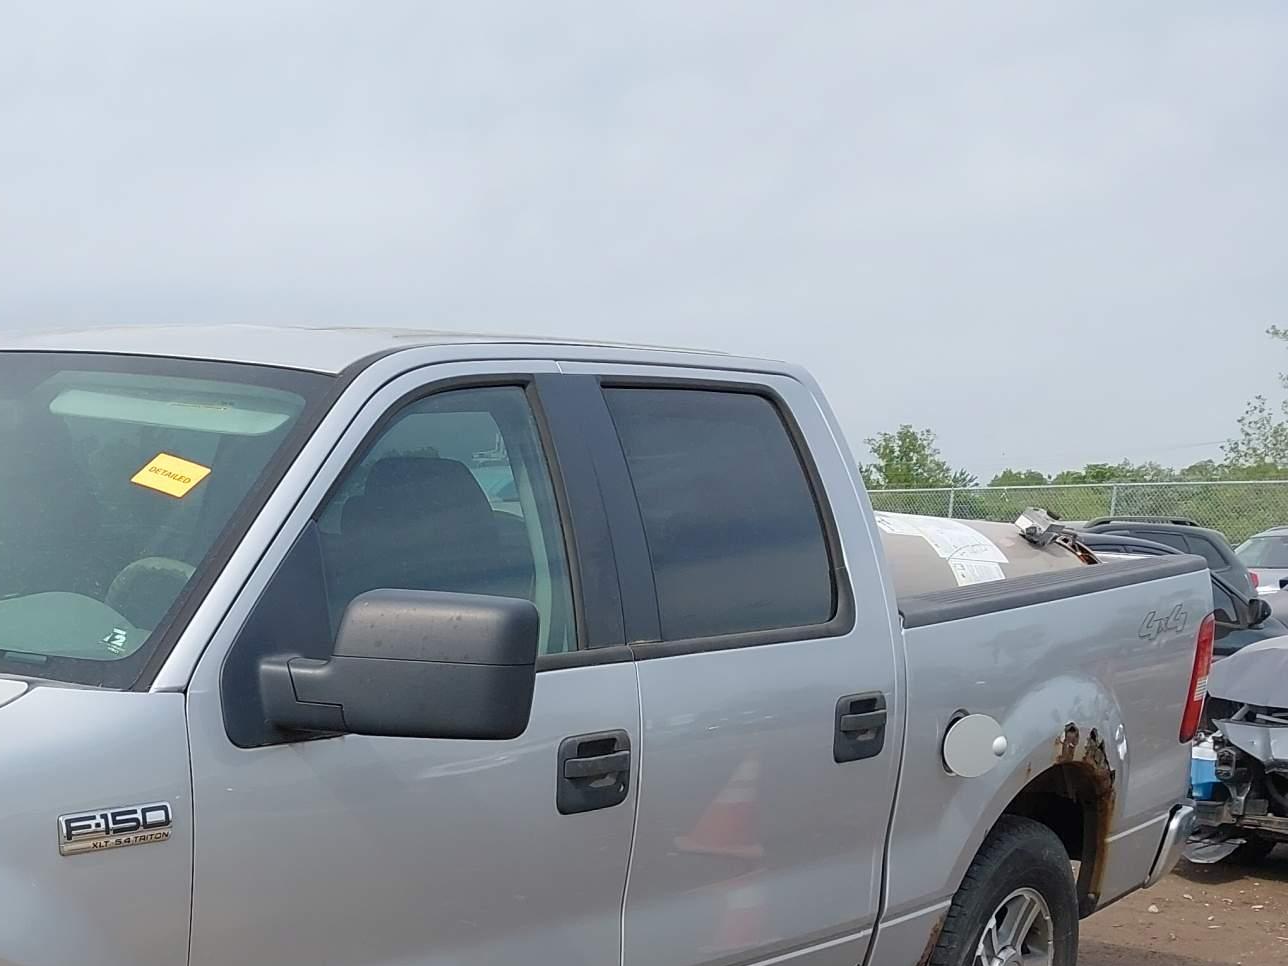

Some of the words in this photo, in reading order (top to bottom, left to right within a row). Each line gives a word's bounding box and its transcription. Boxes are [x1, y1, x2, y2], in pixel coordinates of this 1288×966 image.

[149, 466, 192, 484] DETAILED
[1138, 603, 1187, 641] 4x4
[92, 841, 109, 849] XLT
[134, 832, 169, 843] TRITON
